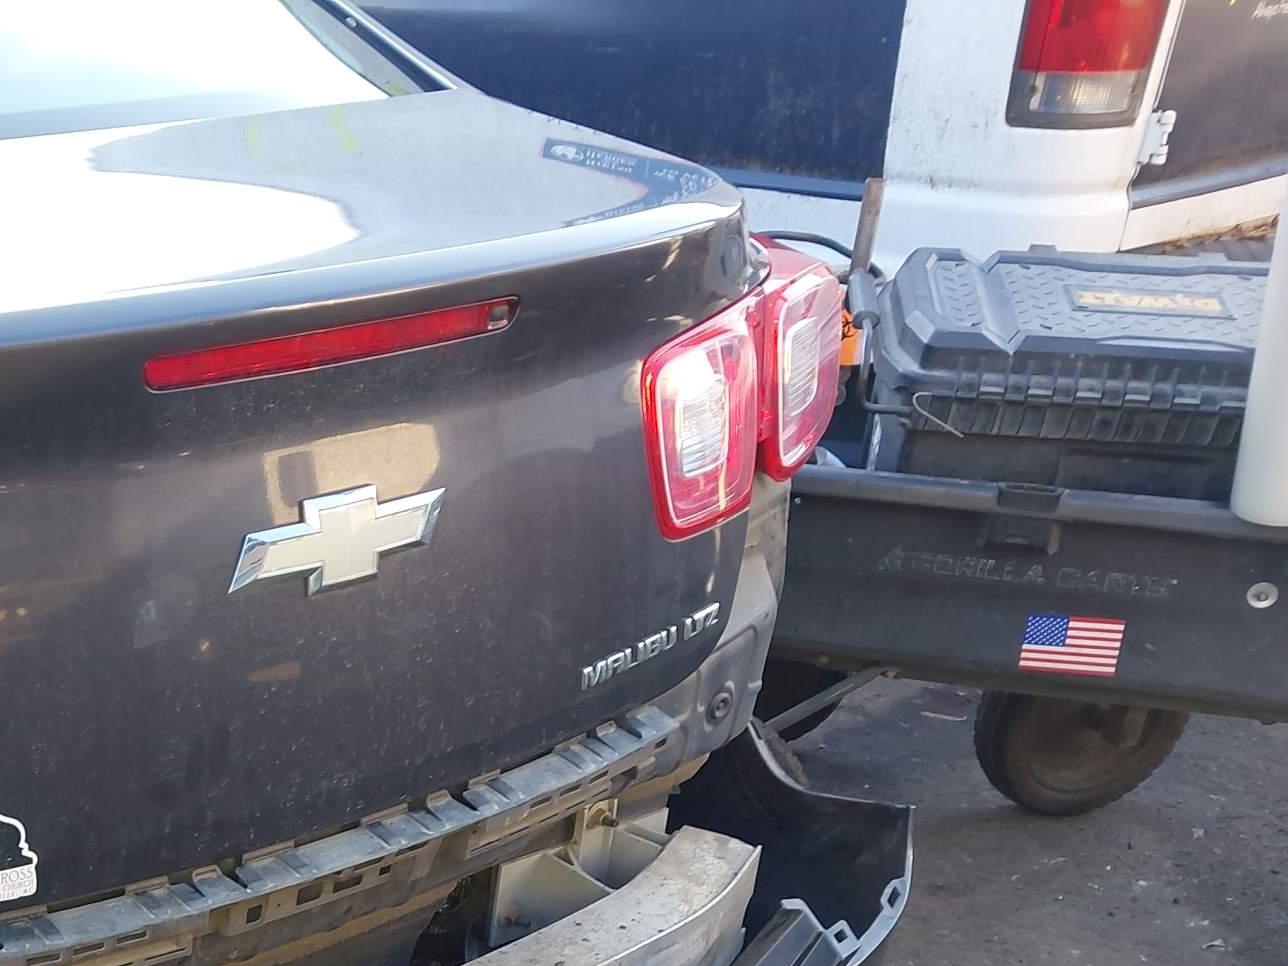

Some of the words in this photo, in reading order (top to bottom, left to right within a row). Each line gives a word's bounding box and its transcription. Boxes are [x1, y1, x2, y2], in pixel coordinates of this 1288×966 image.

[580, 625, 678, 691] MALIBU
[682, 601, 720, 641] LTZ
[3, 880, 34, 893] CHURCH
